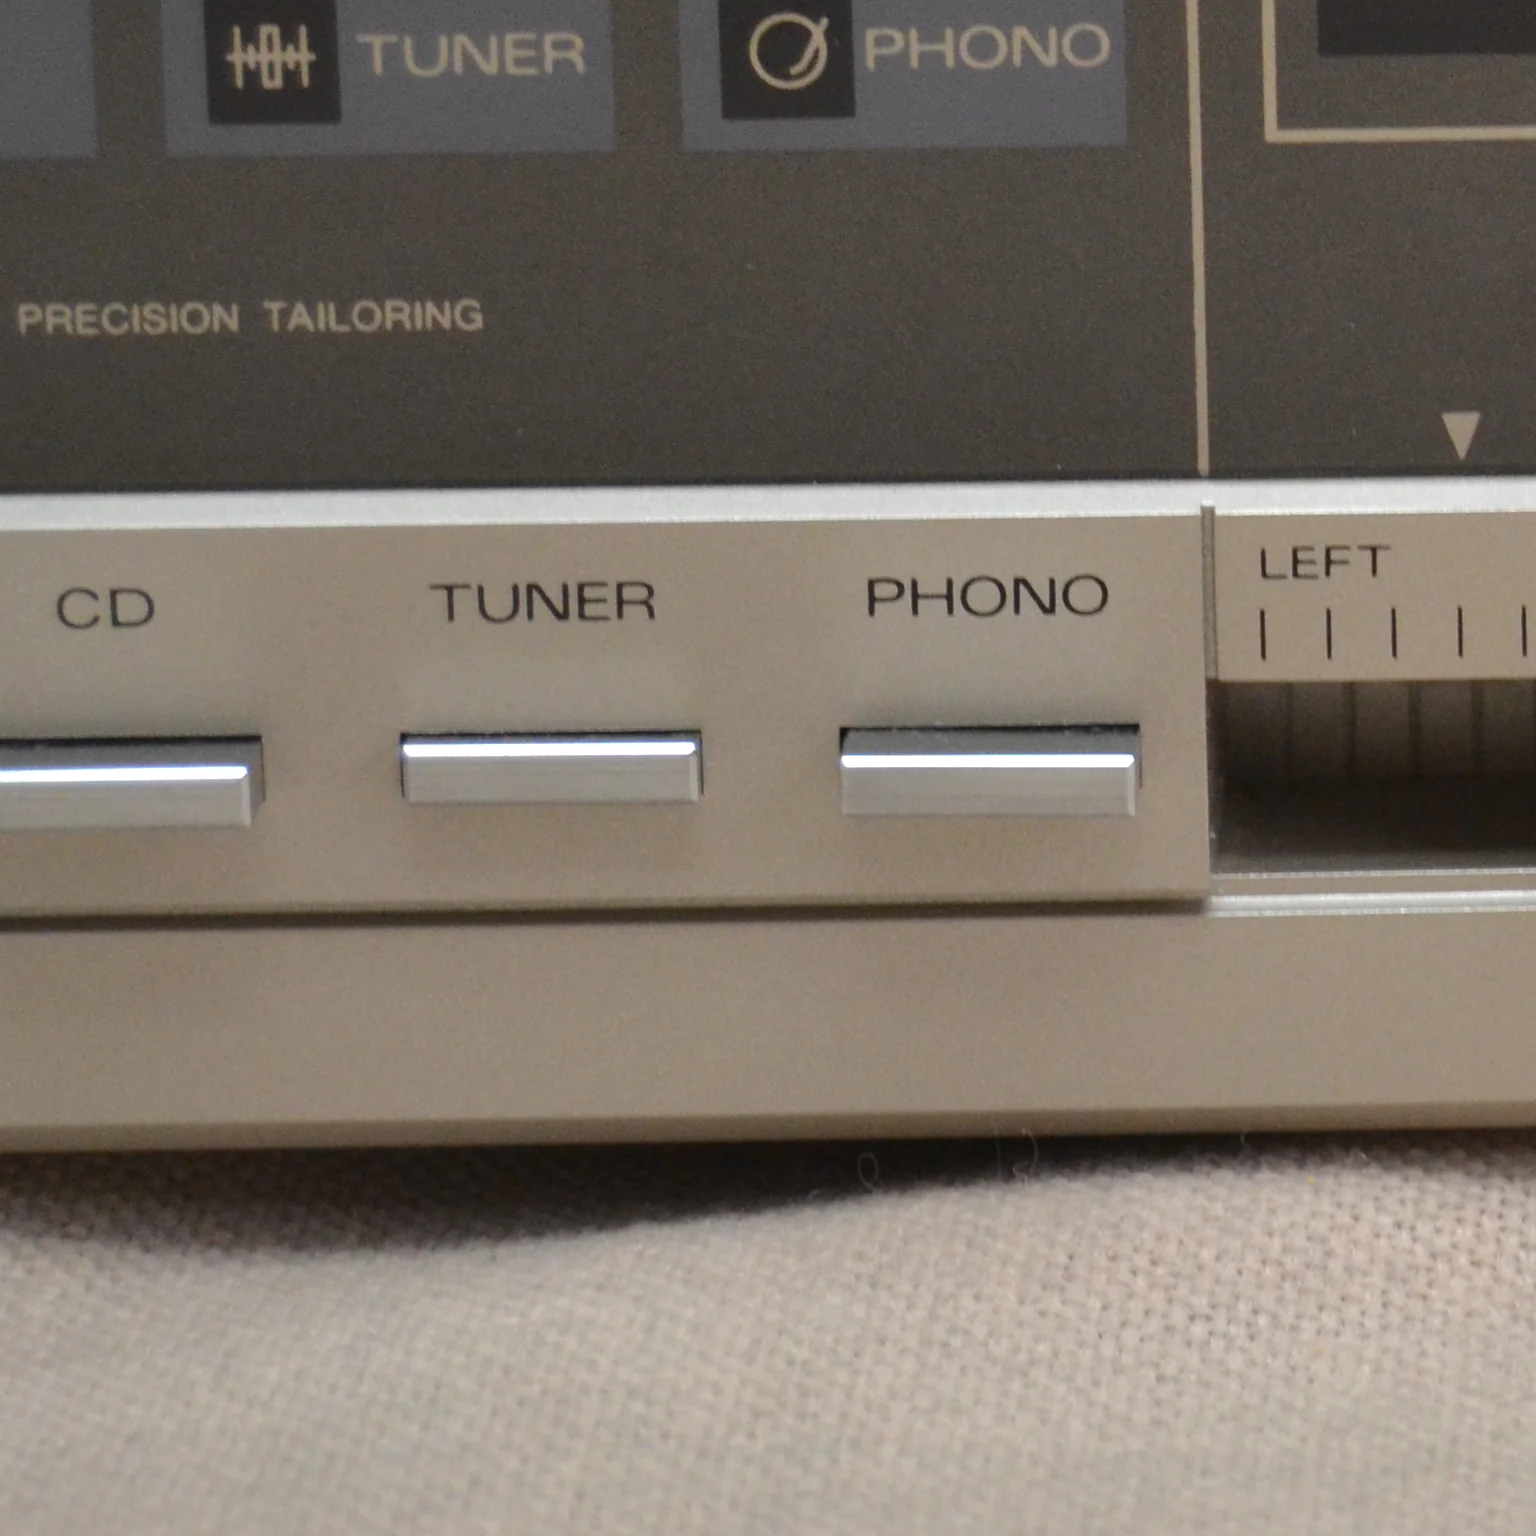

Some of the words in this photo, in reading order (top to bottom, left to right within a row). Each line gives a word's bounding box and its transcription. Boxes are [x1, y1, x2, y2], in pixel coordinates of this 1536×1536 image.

[357, 32, 585, 77] TUNER
[865, 23, 1111, 71] PHONO
[18, 302, 239, 335] PRECISION
[263, 298, 484, 332] TAILORING
[1260, 545, 1391, 580] LEFT
[56, 587, 155, 630] CD
[431, 581, 655, 624] TUNER
[867, 574, 1109, 617] PHONO
